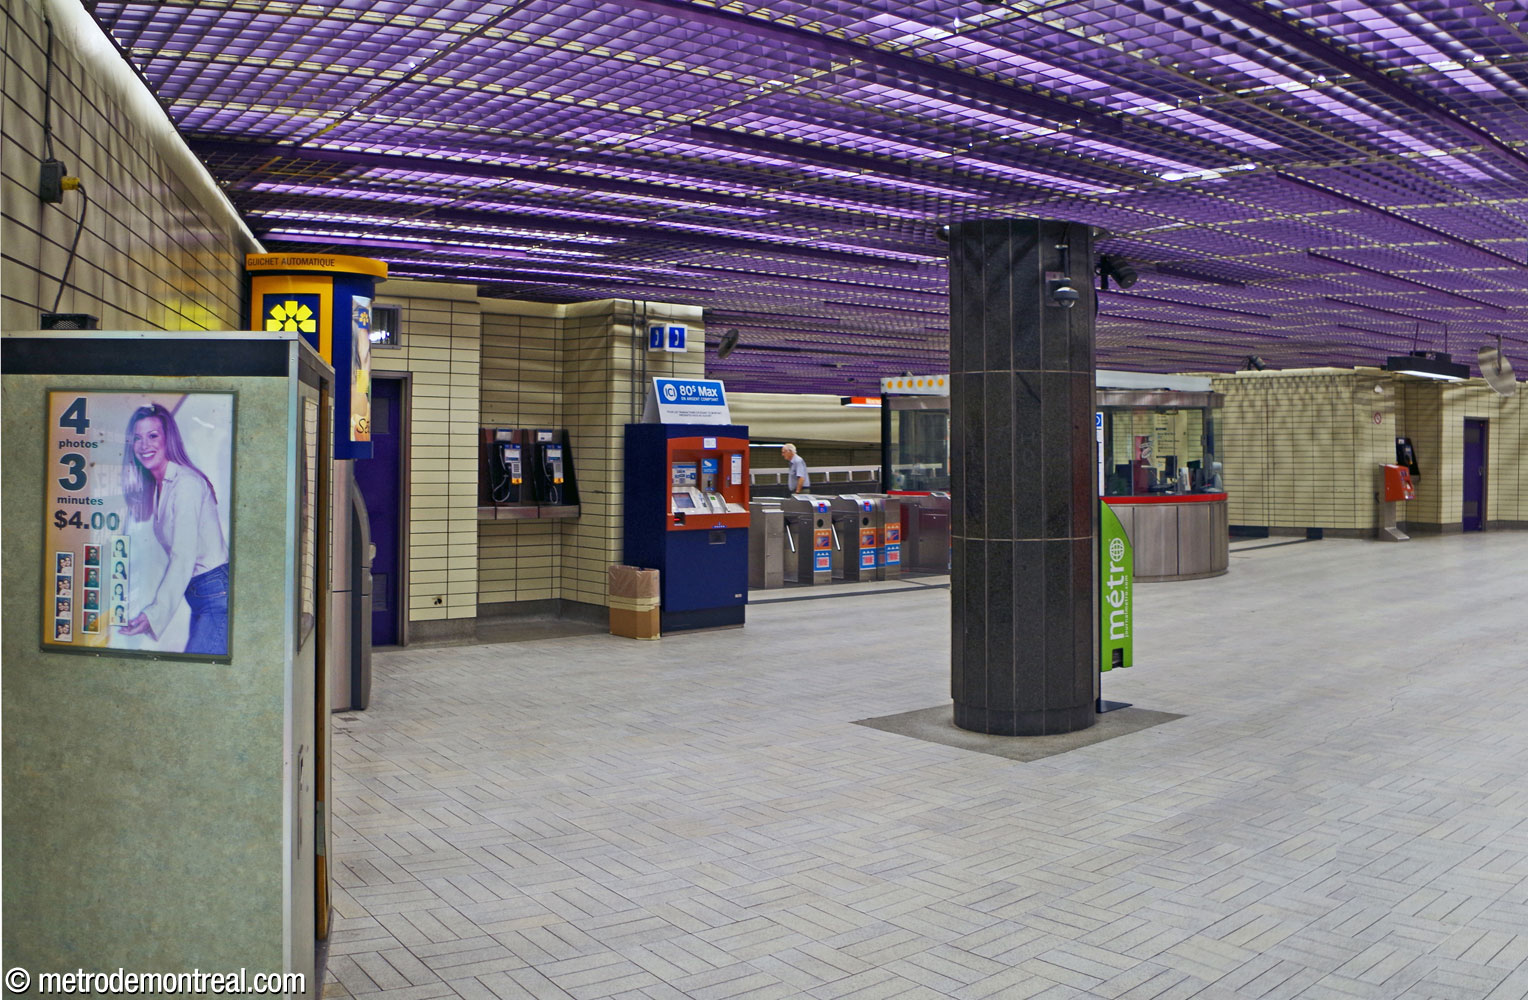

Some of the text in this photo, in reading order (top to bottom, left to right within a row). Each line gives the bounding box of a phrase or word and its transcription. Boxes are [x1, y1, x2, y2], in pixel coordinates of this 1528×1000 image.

[247, 257, 335, 267] GUICHET AUTOMATIQUE
[698, 386, 718, 397] Max
[59, 397, 90, 434] 4
[58, 439, 99, 449] photos
[58, 453, 88, 491] 3
[57, 496, 104, 505] minutes
[54, 509, 120, 531] $4.00
